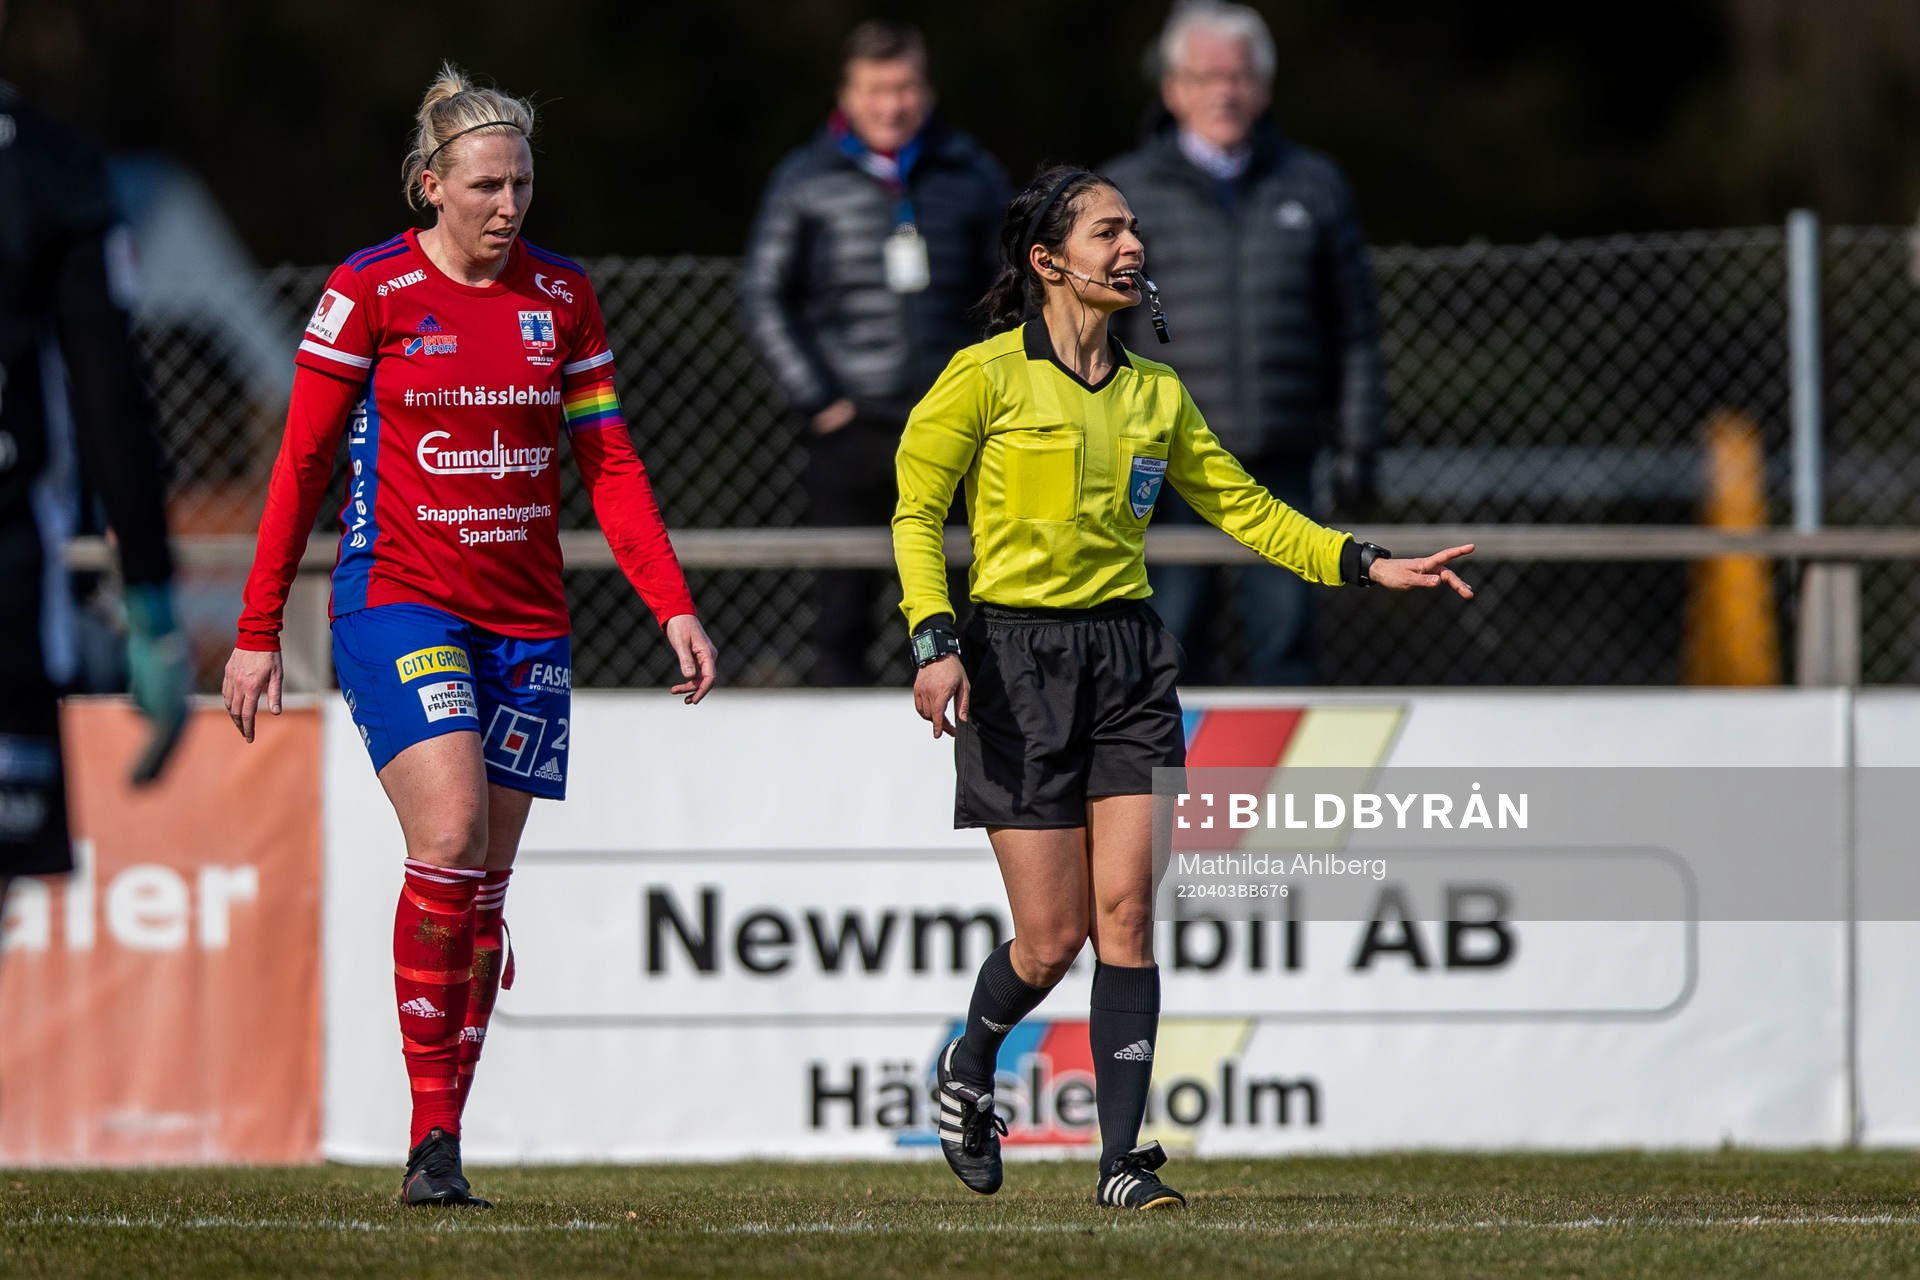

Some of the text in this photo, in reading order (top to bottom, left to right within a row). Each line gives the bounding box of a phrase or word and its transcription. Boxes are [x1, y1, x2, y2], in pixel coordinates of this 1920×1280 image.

[387, 269, 428, 292] NIBE
[551, 284, 574, 304] SHG
[424, 344, 457, 355] SPORT
[417, 430, 551, 480] Emmaljunga
[459, 526, 528, 547] Sparbank
[403, 653, 434, 676] CITY
[530, 663, 571, 688] FASA
[535, 770, 562, 781] adidas
[1351, 884, 1516, 972] AB
[400, 1005, 446, 1018] adidas
[1114, 1050, 1153, 1061] adida
